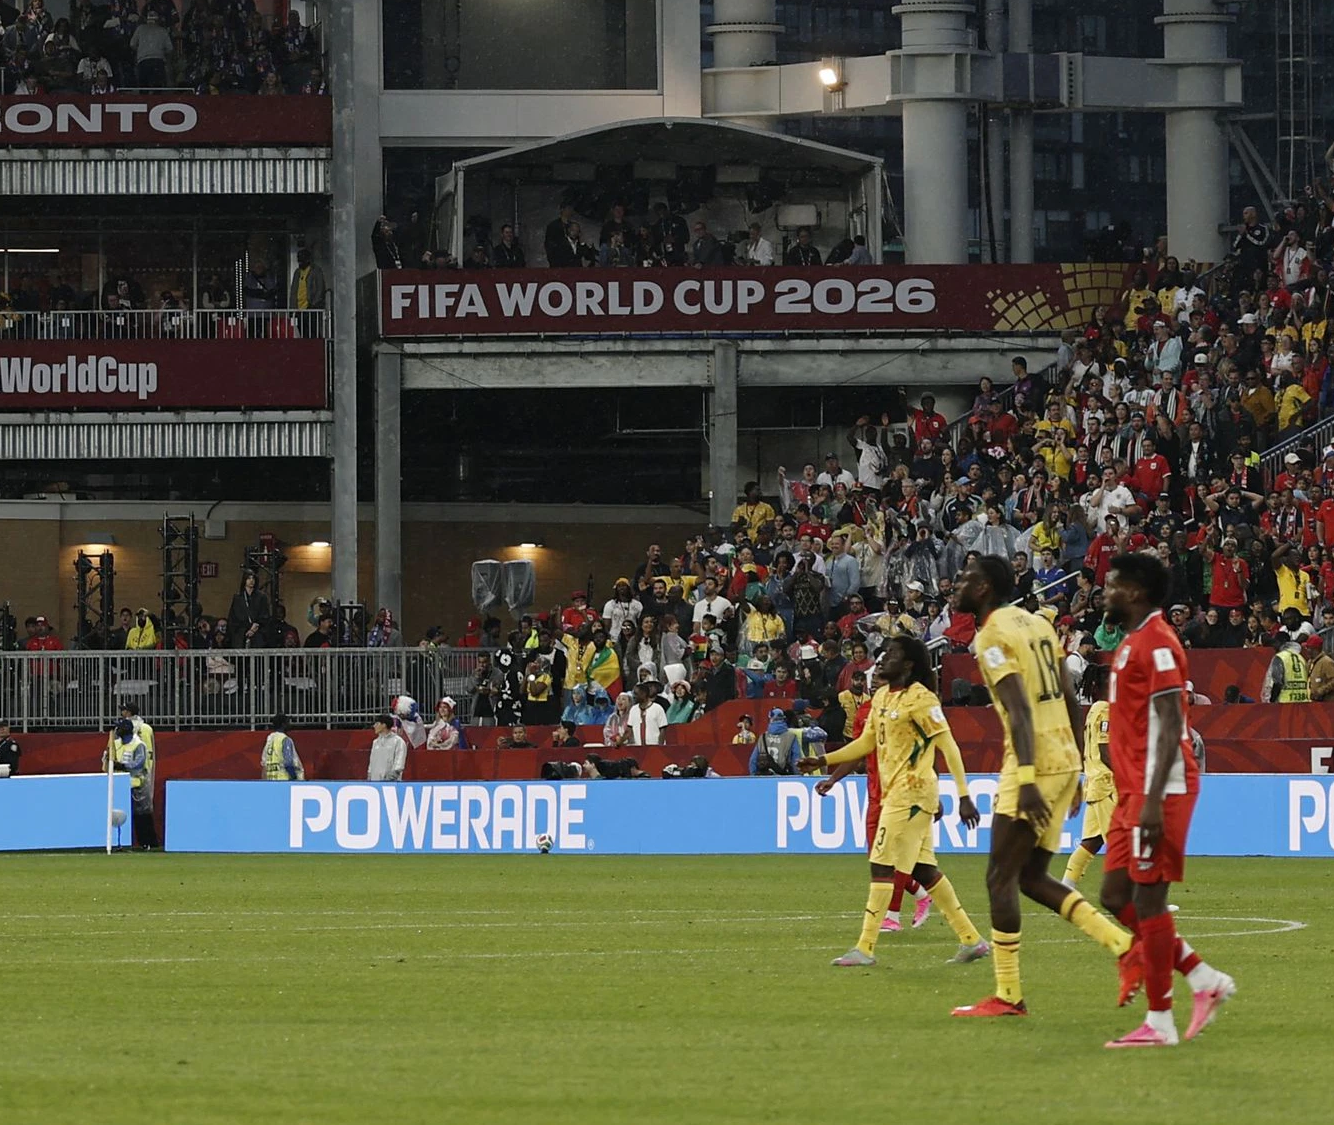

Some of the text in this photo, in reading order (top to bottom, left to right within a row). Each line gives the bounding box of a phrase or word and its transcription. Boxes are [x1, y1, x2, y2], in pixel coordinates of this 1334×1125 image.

[390, 277, 937, 320] FIFA WORLD CUP 2026
[202, 562, 217, 575] EXIT
[1029, 639, 1063, 702] 18
[289, 783, 587, 849] POWERADE
